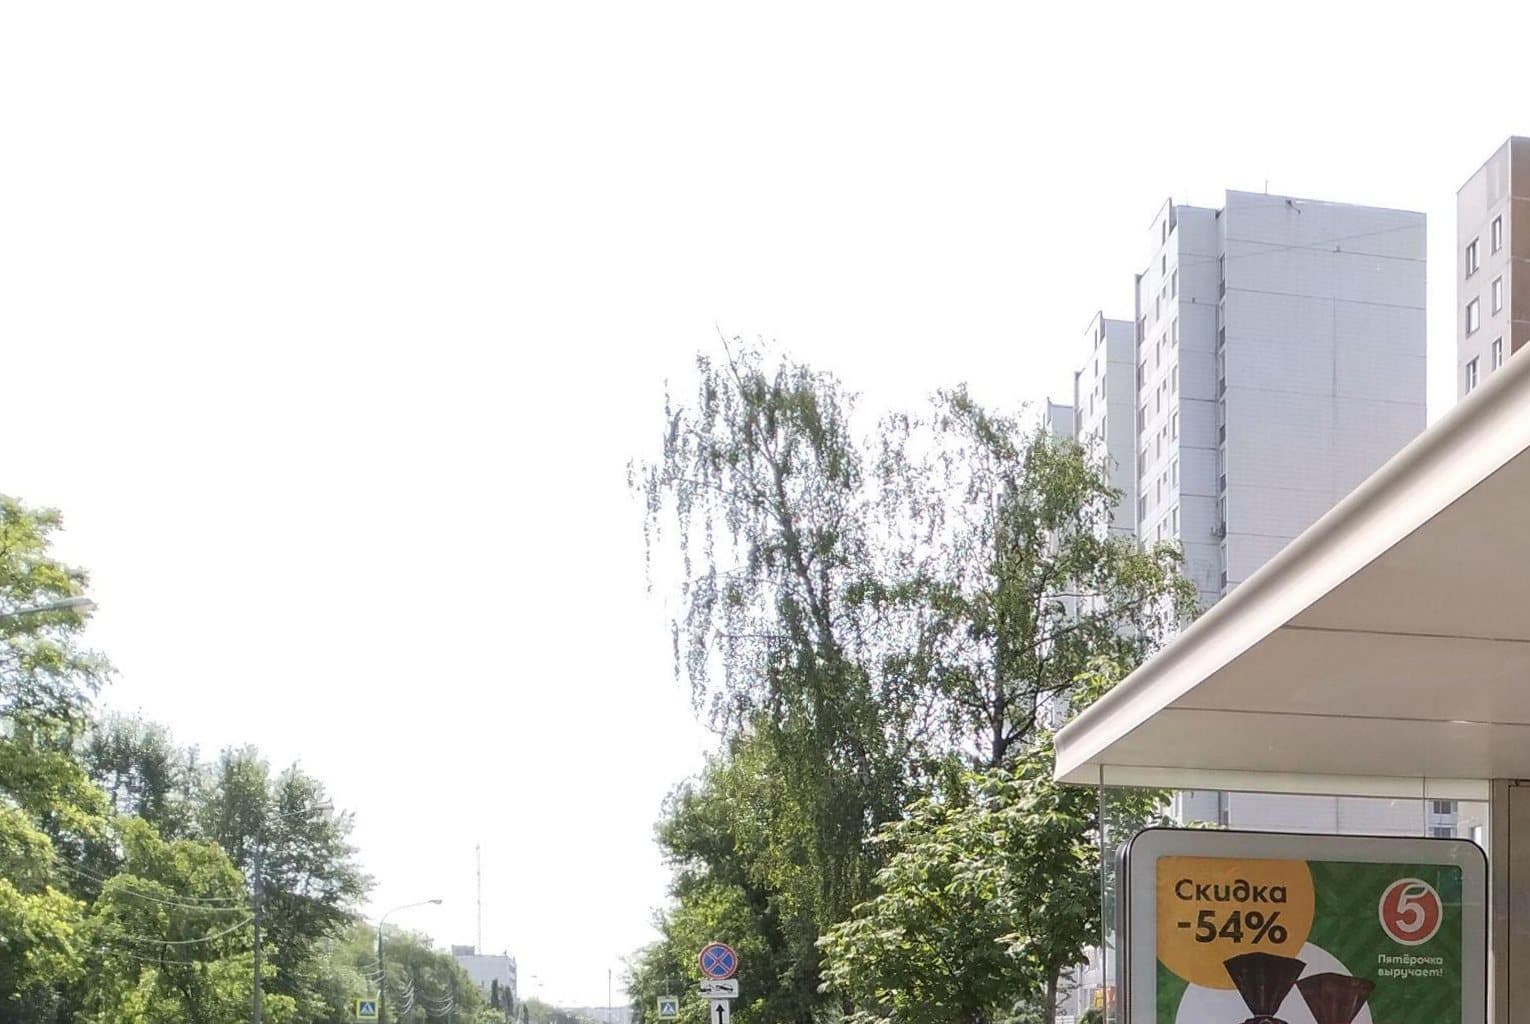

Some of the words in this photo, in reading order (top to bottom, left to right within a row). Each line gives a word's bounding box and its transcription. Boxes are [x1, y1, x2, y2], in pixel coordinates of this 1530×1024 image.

[1174, 878, 1288, 904] Скидка
[1177, 911, 1288, 945] -54%
[1378, 953, 1443, 966] Пятёрочка
[1378, 968, 1443, 979] выручает!
